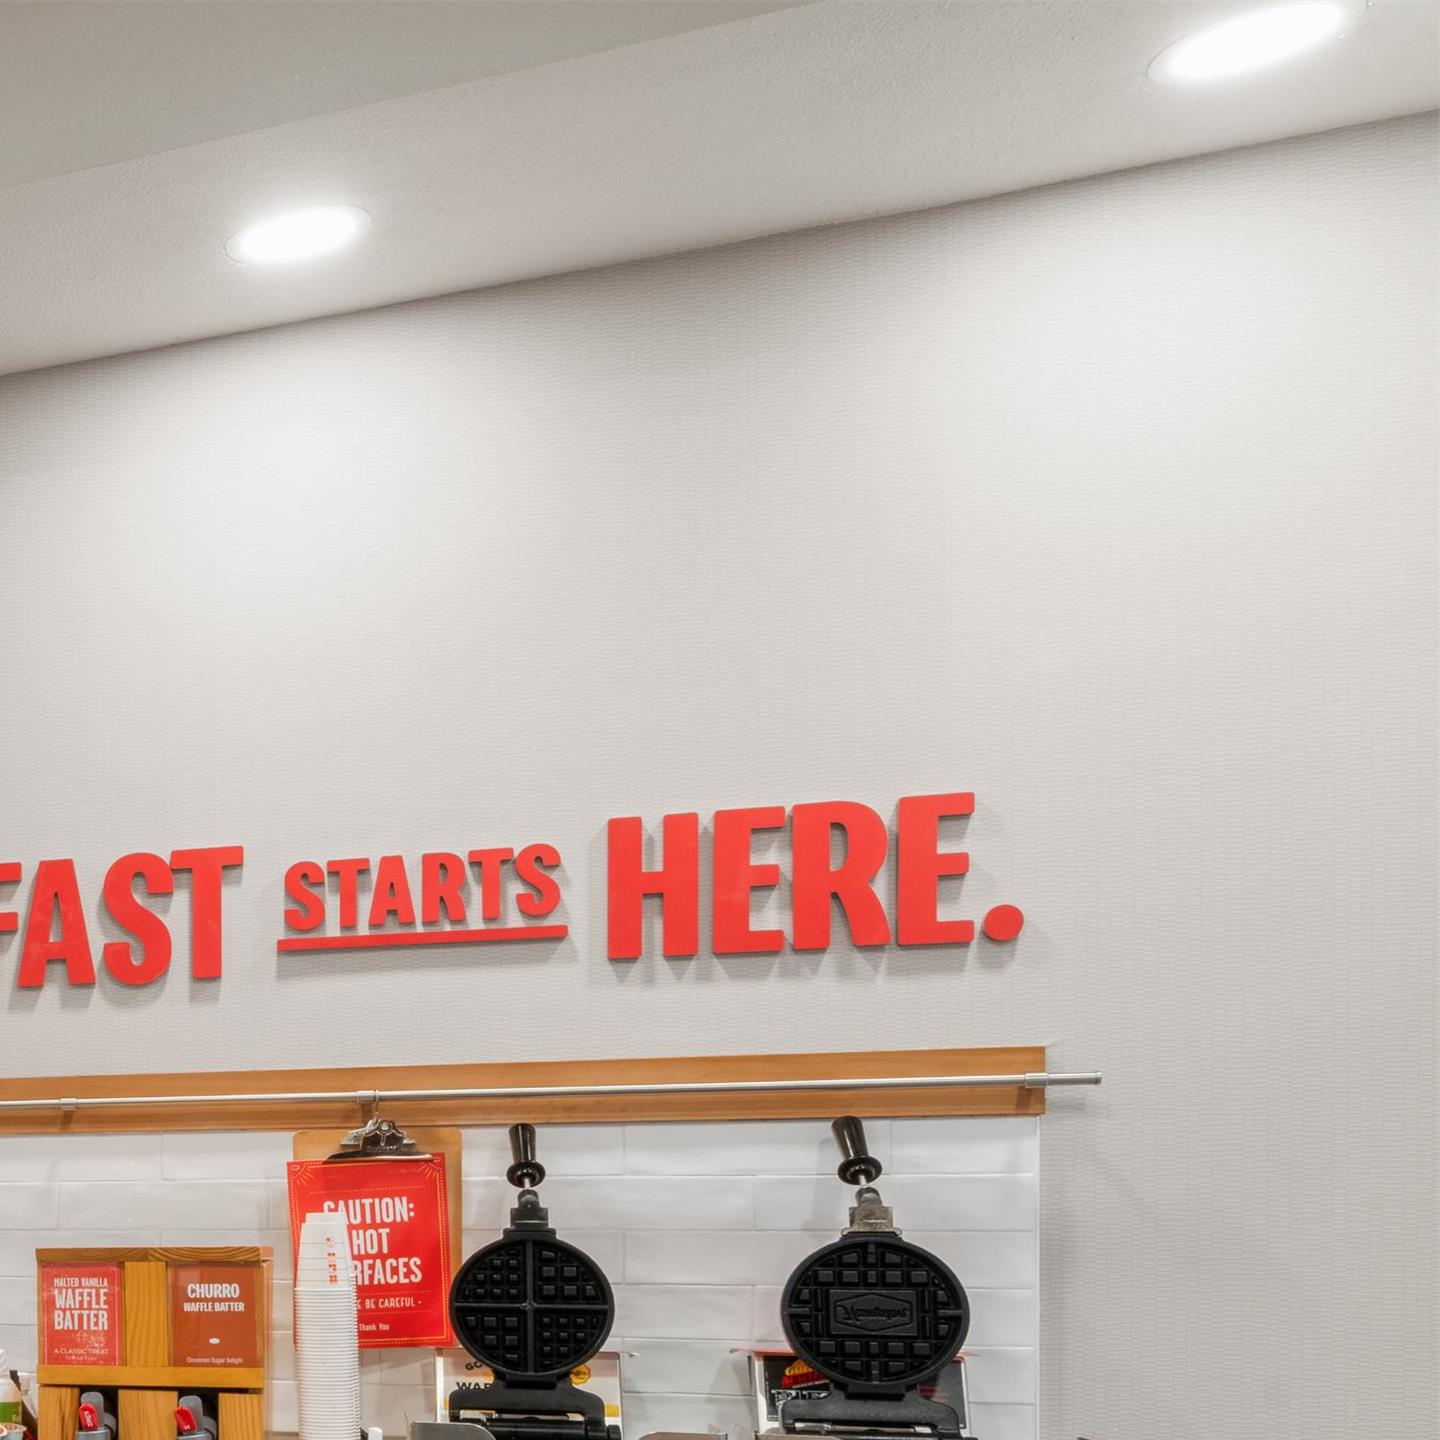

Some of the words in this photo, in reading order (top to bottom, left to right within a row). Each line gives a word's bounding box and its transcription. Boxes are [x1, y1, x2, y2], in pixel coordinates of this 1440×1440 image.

[284, 843, 560, 931] STARTS
[608, 792, 1023, 959] HERE.
[351, 1228, 390, 1255] HOT
[354, 1257, 422, 1285] RFACES
[54, 1277, 79, 1287] MALTED
[81, 1277, 108, 1287] VANILLA
[187, 1283, 239, 1298] CHURRO
[54, 1288, 108, 1309] WAFFLE
[183, 1302, 213, 1312] WAFFLE
[214, 1302, 245, 1312] BATTER
[365, 1298, 376, 1309] BE
[378, 1297, 415, 1308] CAREFUL
[54, 1310, 108, 1330] BATTER
[378, 1322, 390, 1332] You
